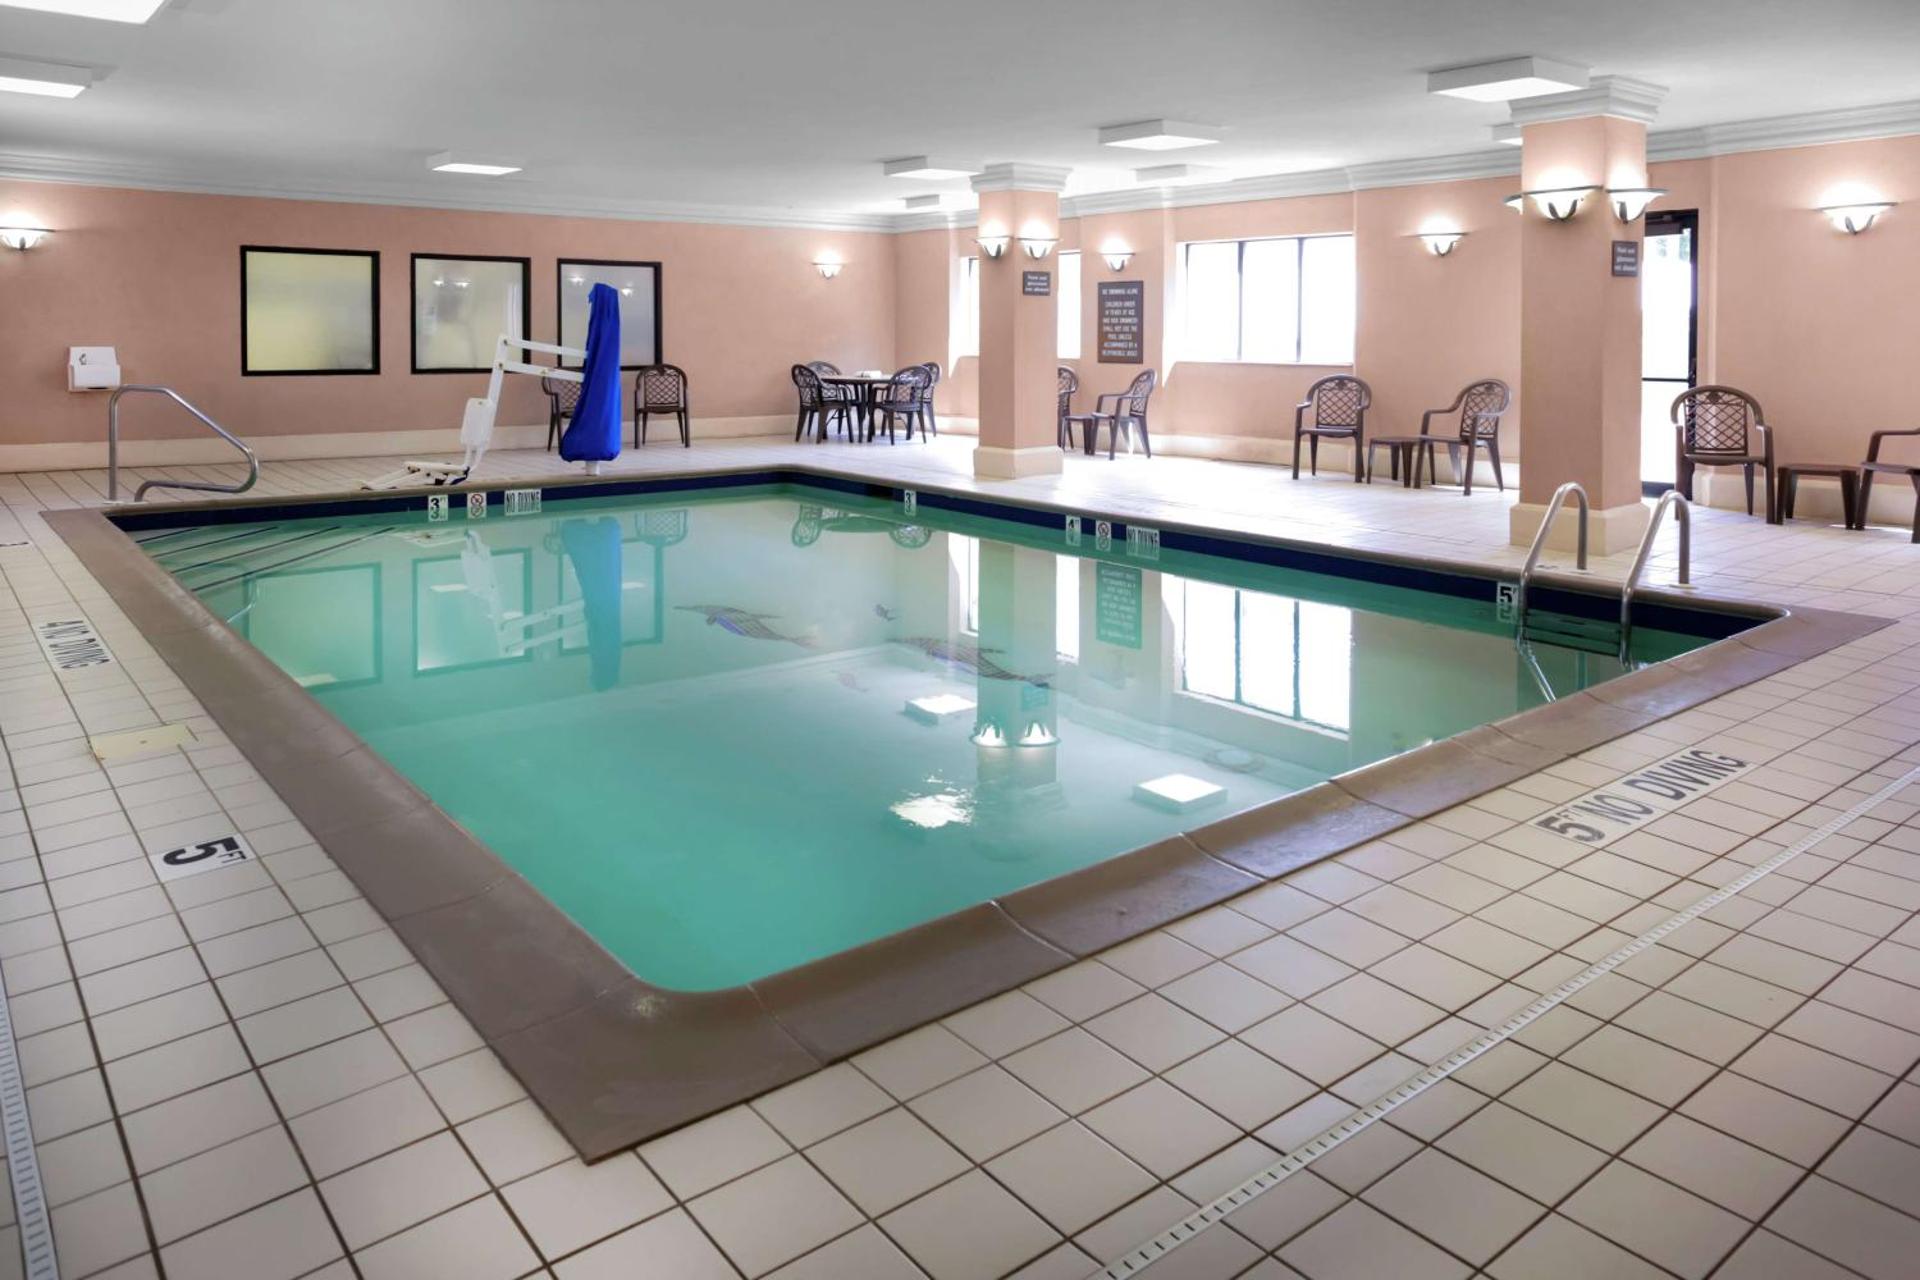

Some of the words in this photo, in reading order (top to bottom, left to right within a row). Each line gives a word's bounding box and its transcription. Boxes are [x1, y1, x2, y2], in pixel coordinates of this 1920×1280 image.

[1500, 586, 1512, 603] 5
[1536, 816, 1606, 842] 5
[1573, 794, 1653, 825] NO
[1622, 750, 1747, 800] DIVING
[163, 837, 239, 865] 5
